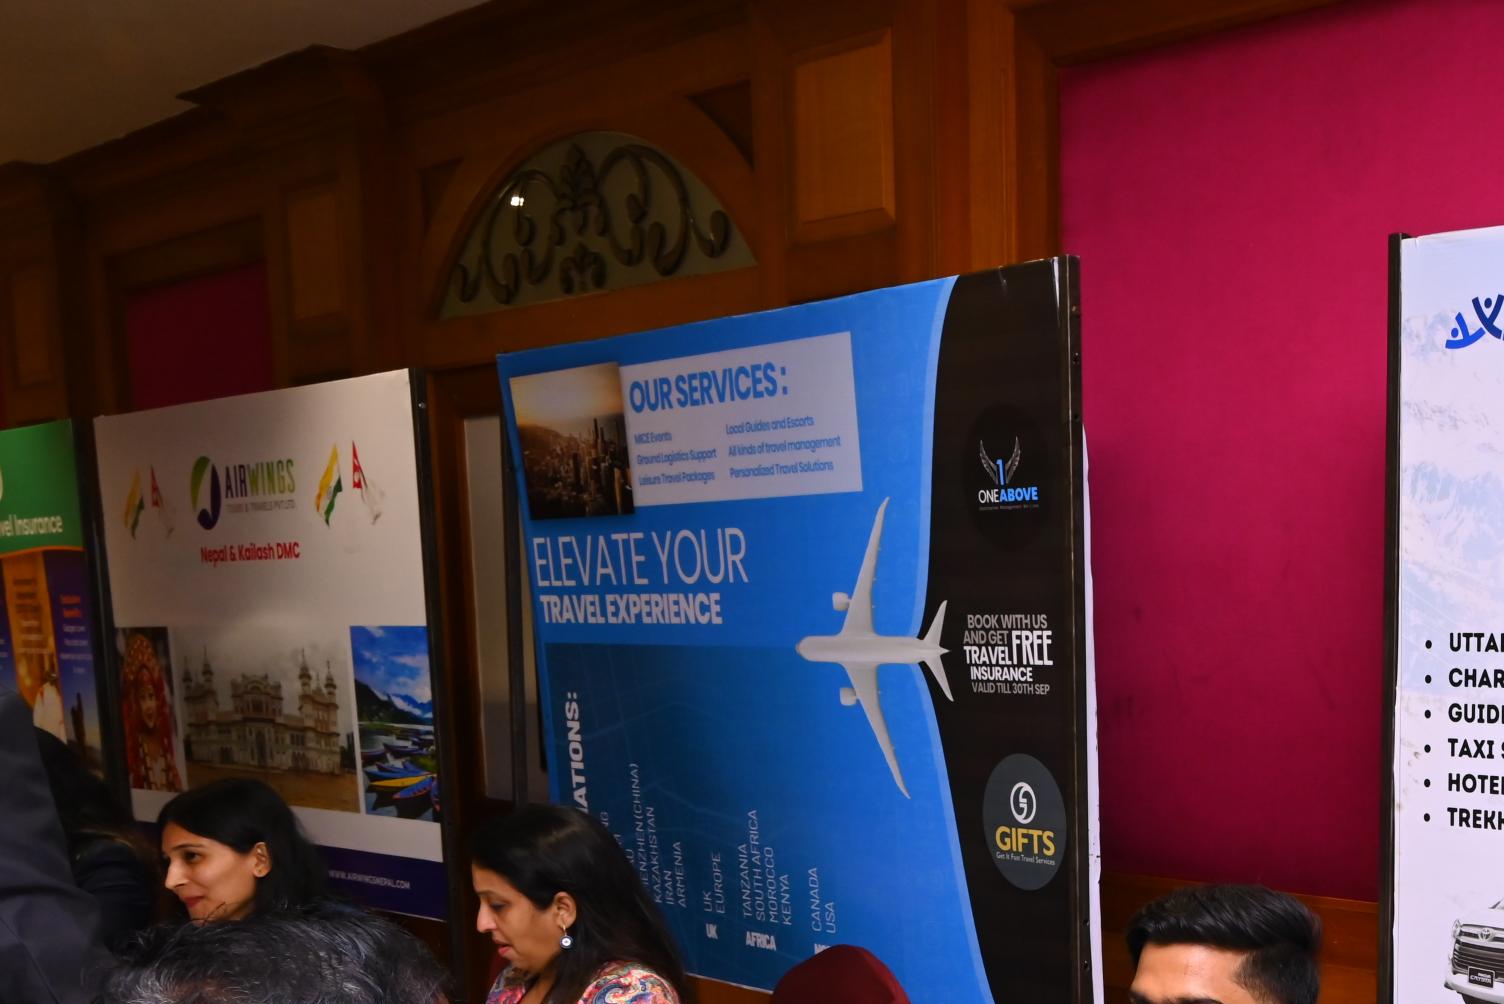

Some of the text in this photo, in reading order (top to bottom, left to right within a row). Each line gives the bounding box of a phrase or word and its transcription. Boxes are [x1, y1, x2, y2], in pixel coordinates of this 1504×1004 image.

[629, 377, 674, 414] OUR
[675, 361, 778, 408] SERVICES
[650, 432, 672, 443] Events
[726, 415, 814, 435] Local Guides and Escorts
[637, 454, 660, 465] Ground
[689, 448, 717, 463] Support
[728, 435, 841, 457] All kinds of travel management
[225, 458, 296, 499] AIRWINGS
[729, 460, 834, 479] Personalized Travel Solutions
[13, 513, 64, 536] Insurance
[200, 541, 301, 568] Nepal & Kailash DMC
[532, 527, 750, 587] ELEVATE YOUR
[539, 592, 723, 625] TRAVEL EXPERIENCE
[967, 614, 1048, 629] BOOK WITH US
[963, 630, 1054, 666] AND GET FREE
[963, 645, 1012, 665] TRAVEL
[970, 666, 1033, 682] INSURANCE
[971, 682, 1050, 695] VALID TILL 30TH SEP
[564, 691, 589, 814] ATIONS:
[1447, 738, 1495, 759] TAXI
[645, 806, 663, 903] KAZAKHSTAN
[995, 825, 1056, 857] GIFTS
[672, 841, 687, 908] ARMENIA
[737, 843, 752, 918] TANZANIA
[747, 809, 766, 922] SOUTH AFRICA
[663, 870, 674, 905] IRAN
[711, 852, 725, 914] EUROPE
[763, 846, 780, 923] MOROCCO
[808, 867, 822, 932] CANADA
[703, 890, 713, 912] UK
[779, 874, 792, 926] KENYA
[824, 901, 837, 934] USA
[745, 931, 777, 951] AFRICA
